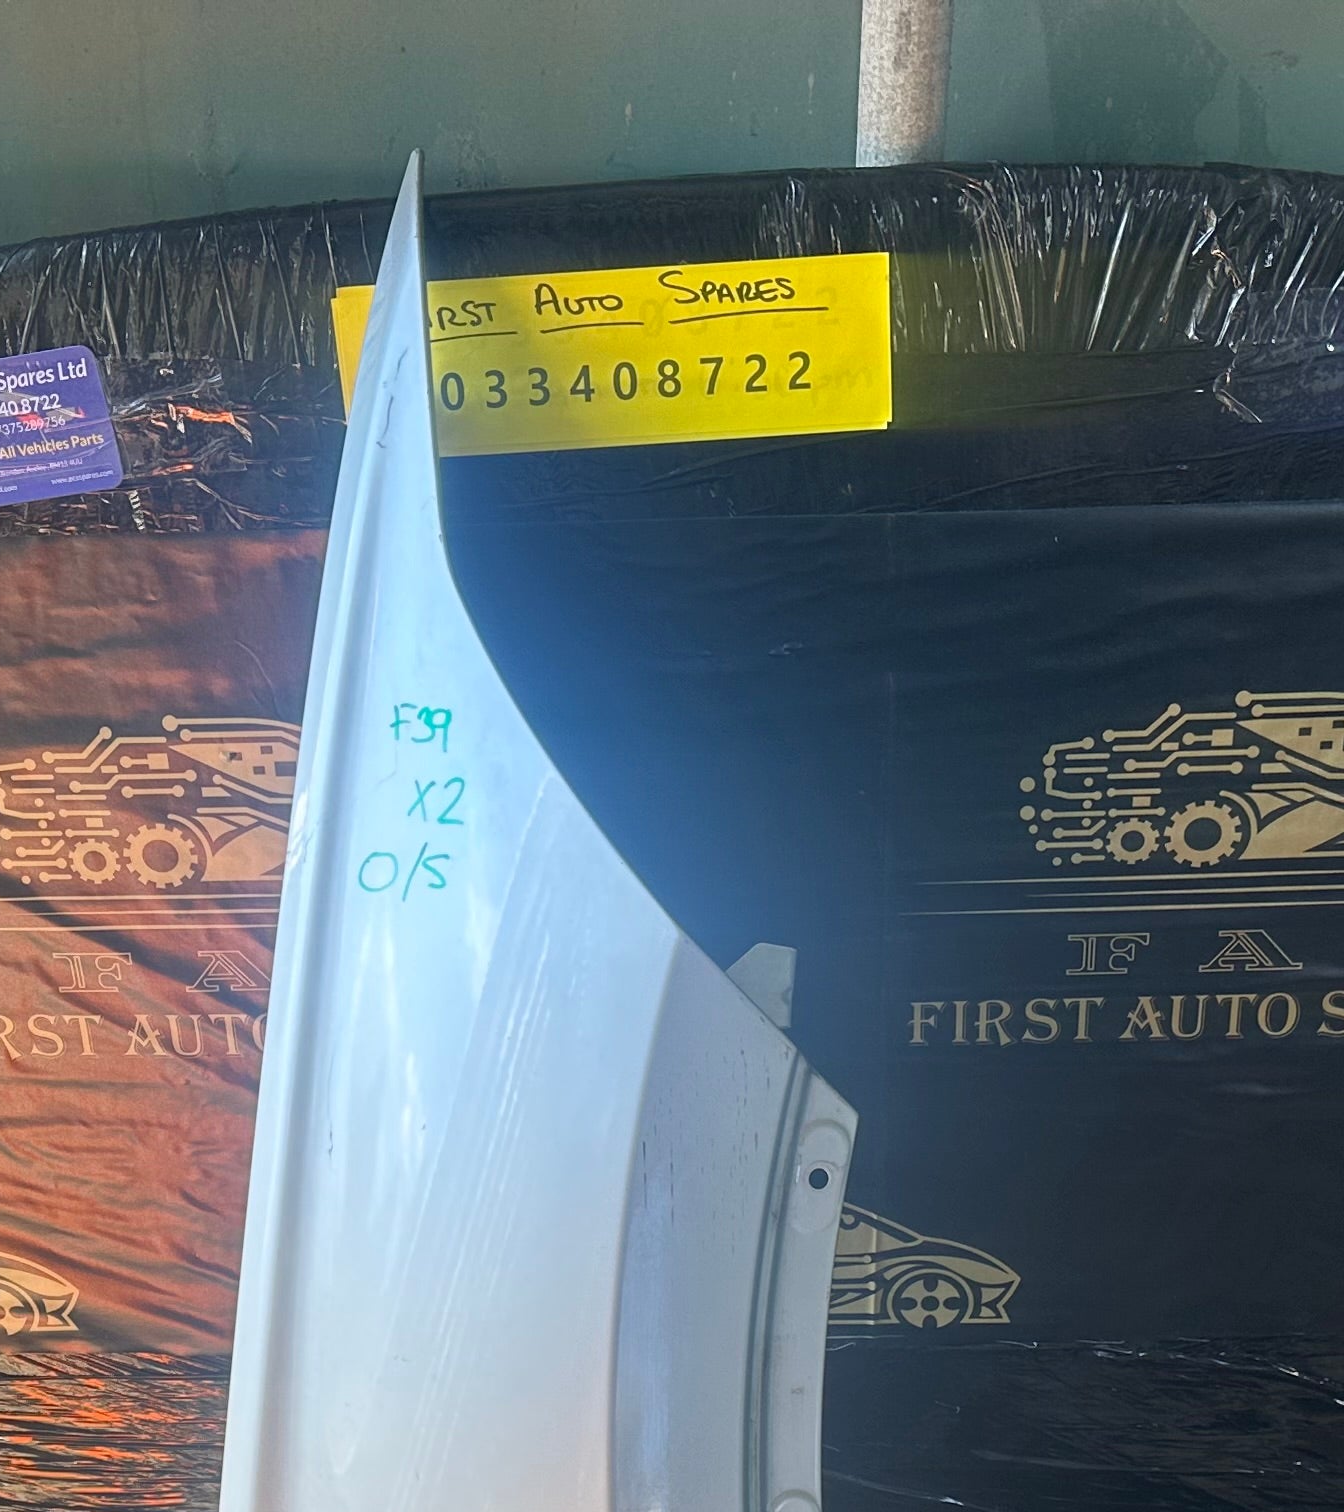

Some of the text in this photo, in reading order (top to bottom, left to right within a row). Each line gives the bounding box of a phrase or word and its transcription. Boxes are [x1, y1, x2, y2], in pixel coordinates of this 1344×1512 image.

[429, 300, 497, 331] RST
[659, 270, 797, 306] SPARES
[58, 358, 88, 382] Ltd
[440, 350, 812, 412] 033408722
[21, 393, 62, 414] 8722
[0, 445, 16, 459] All
[17, 438, 70, 456] Vehicles
[71, 433, 105, 448] Parts
[408, 776, 465, 825] X2
[52, 950, 271, 993] FA
[907, 996, 1106, 1048] FIRST
[1118, 991, 1302, 1041] AUTO
